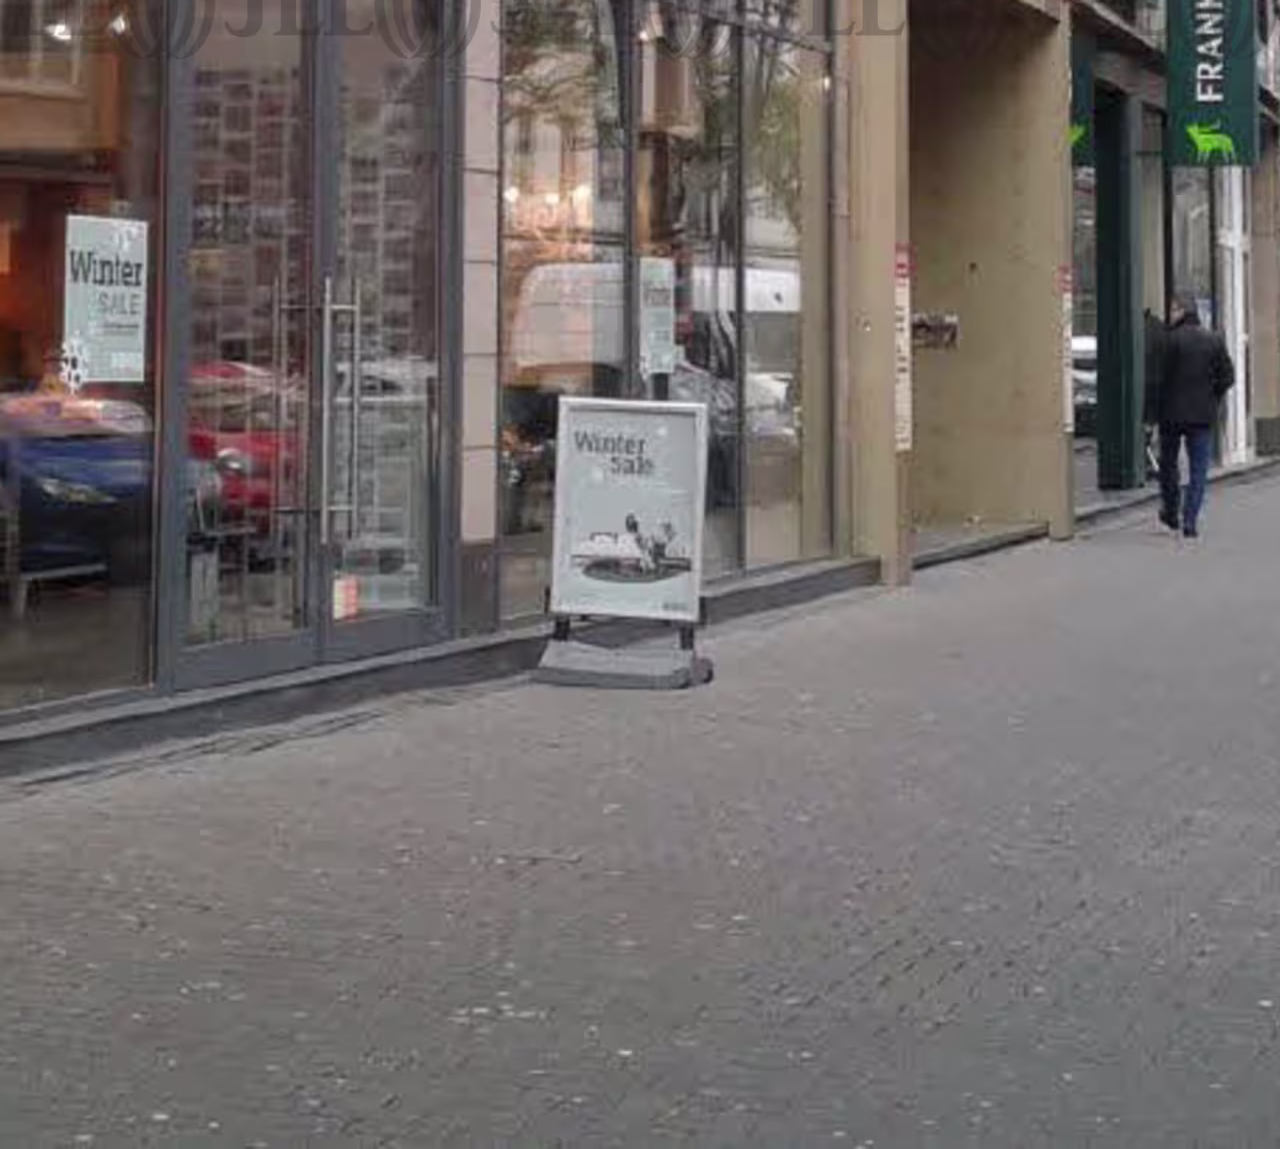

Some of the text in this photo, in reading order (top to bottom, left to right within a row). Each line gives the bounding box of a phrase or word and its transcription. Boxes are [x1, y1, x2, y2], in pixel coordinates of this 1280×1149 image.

[70, 249, 144, 288] Winter
[98, 292, 142, 316] SALE
[573, 430, 646, 456] Winter
